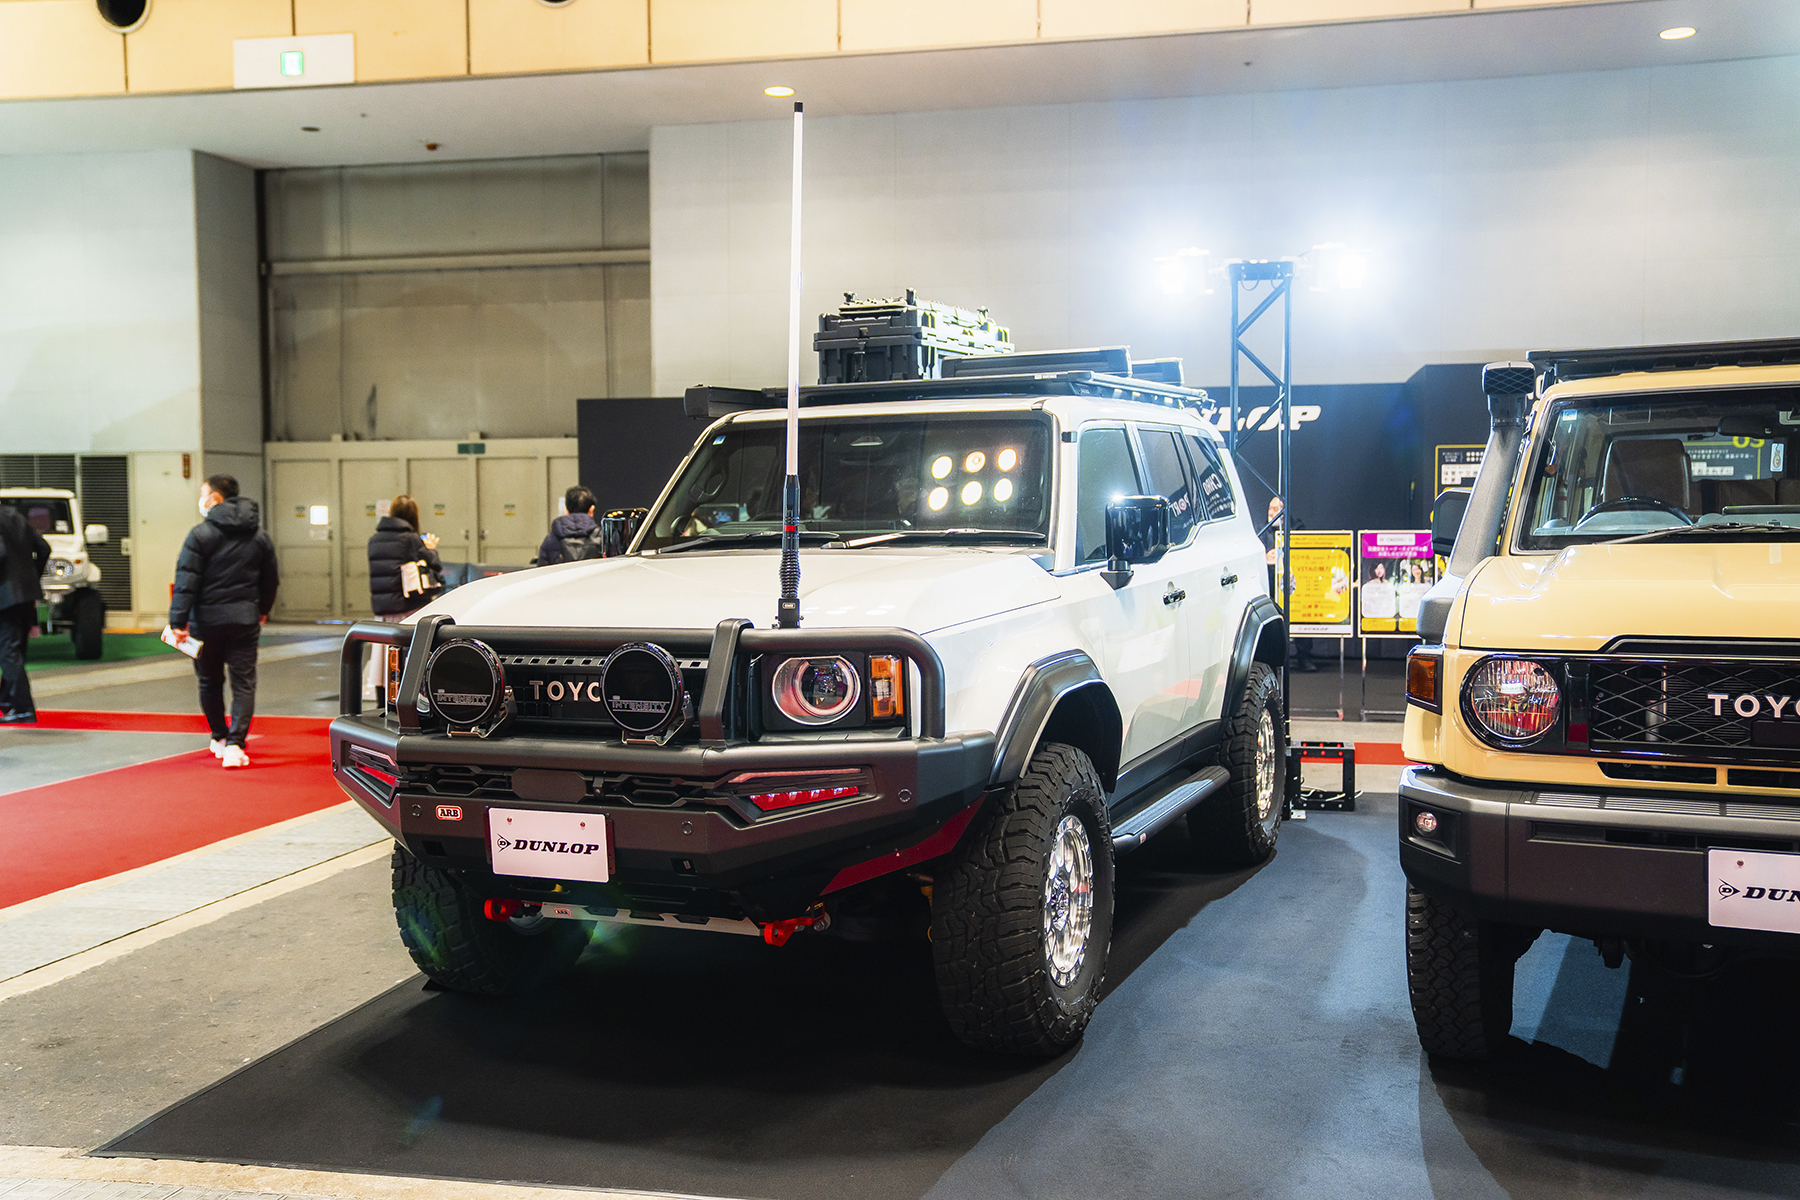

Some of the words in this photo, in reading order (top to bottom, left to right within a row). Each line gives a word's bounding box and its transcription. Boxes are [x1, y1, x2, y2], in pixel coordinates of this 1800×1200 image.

[1707, 693, 1800, 718] TOY
[439, 808, 459, 818] ARB
[513, 839, 600, 855] DUNLOP
